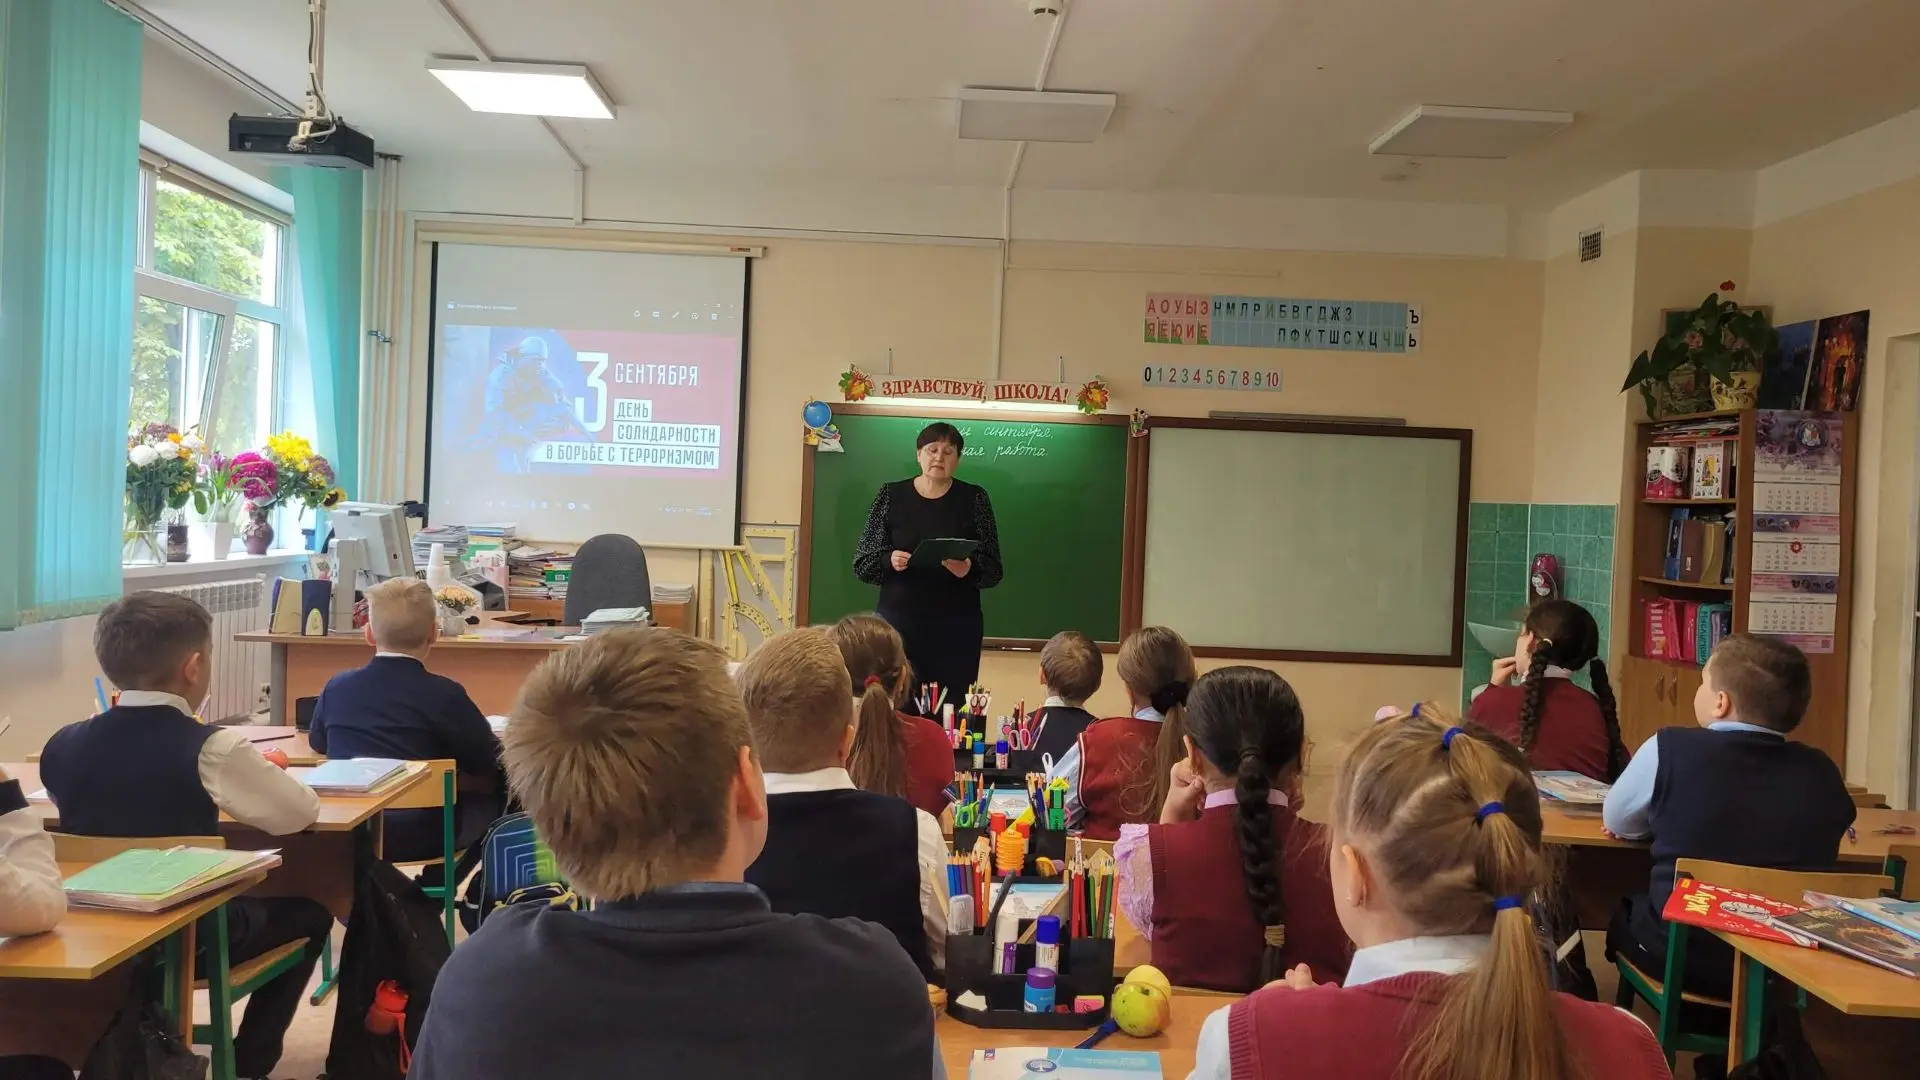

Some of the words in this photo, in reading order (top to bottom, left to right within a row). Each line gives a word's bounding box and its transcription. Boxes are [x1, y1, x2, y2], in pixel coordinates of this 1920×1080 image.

[574, 351, 609, 432] 3
[615, 362, 698, 386] СЕНТЯБРЯ
[882, 379, 987, 403] ЗДРАВСТВУЙ,
[994, 383, 1070, 403] ШКОЛА!
[616, 402, 649, 419] ДЕНЬ
[617, 424, 716, 443] СОЛИДАРНОСТИ
[546, 444, 553, 459] В
[557, 444, 604, 462] БОРЬБЕ
[607, 447, 615, 462] С
[620, 447, 715, 466] ТЕРРОРИЗМОМ
